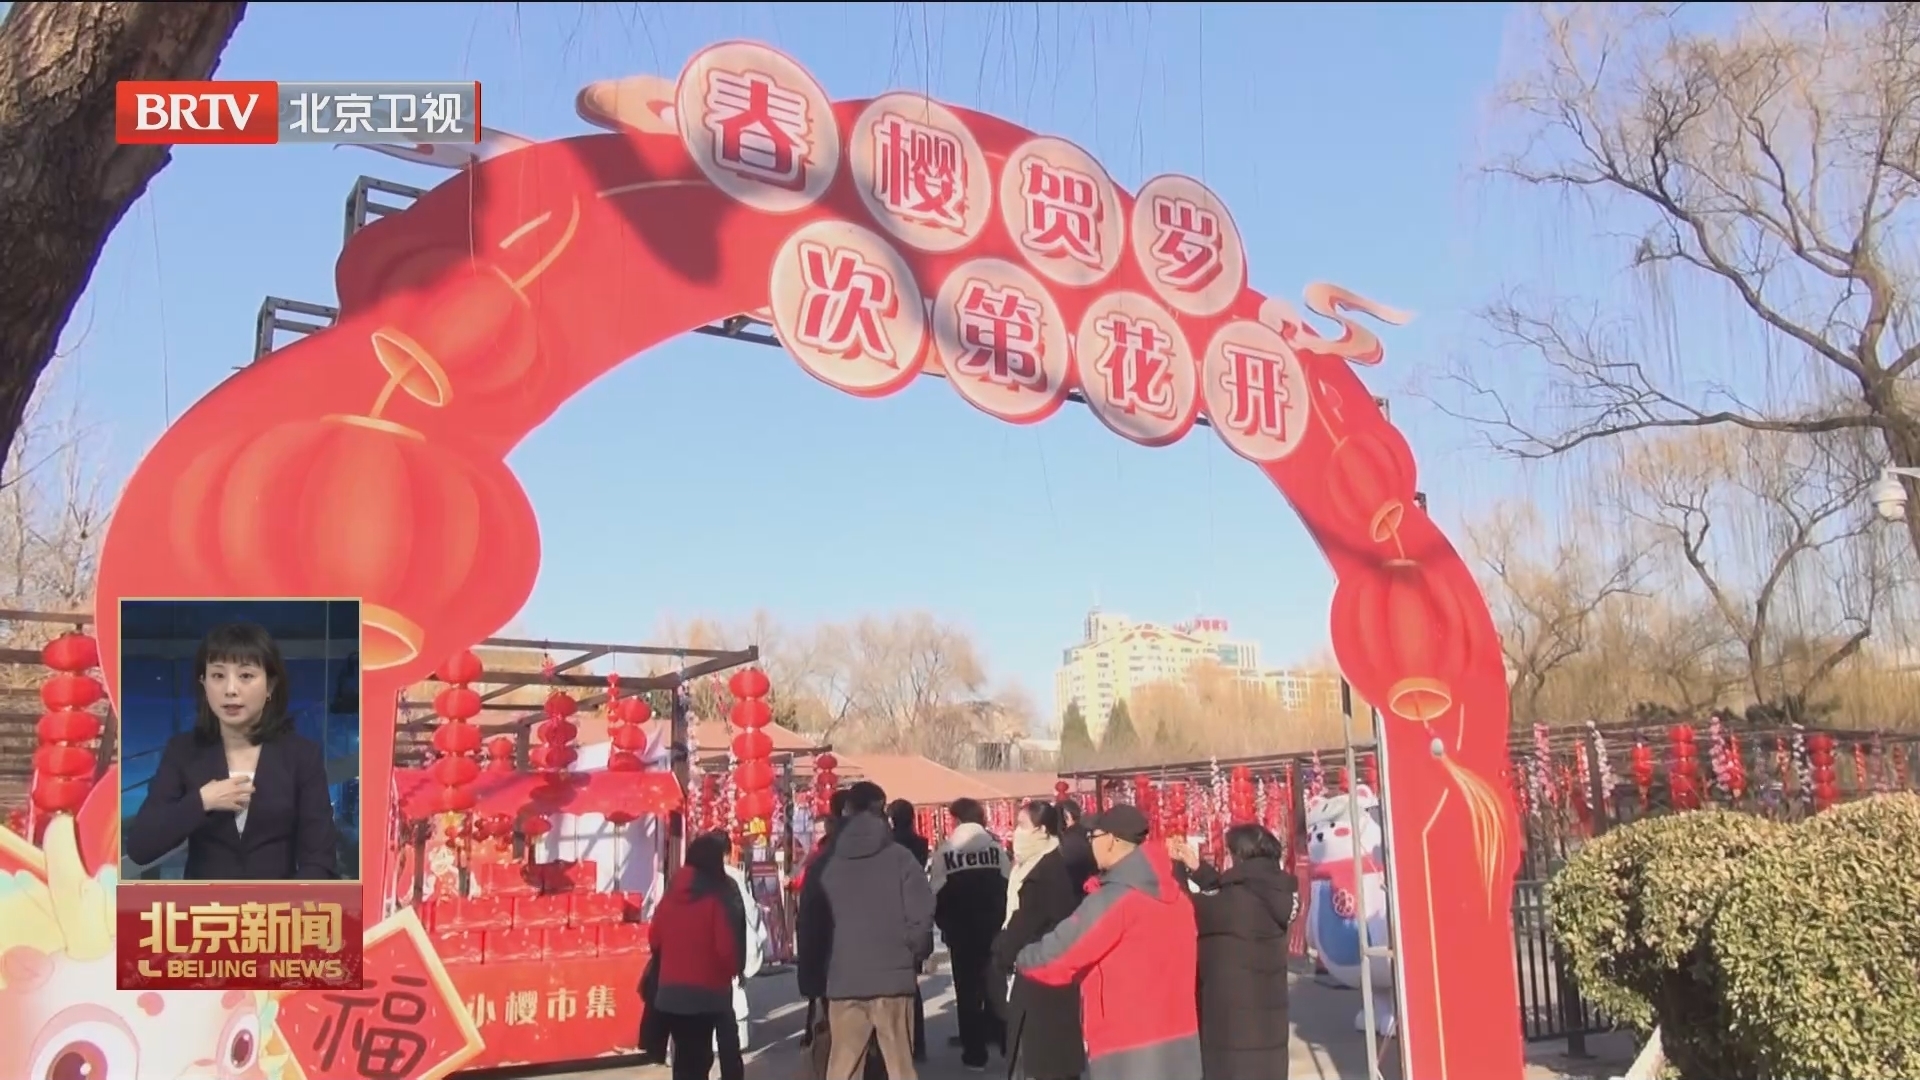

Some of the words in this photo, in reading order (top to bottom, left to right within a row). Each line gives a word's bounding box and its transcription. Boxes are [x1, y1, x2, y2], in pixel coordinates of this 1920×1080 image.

[705, 69, 1222, 291] 春樱贺岁
[797, 241, 1292, 441] 次第花开
[313, 975, 428, 1080] 福
[468, 984, 617, 1028] 小樱市集
